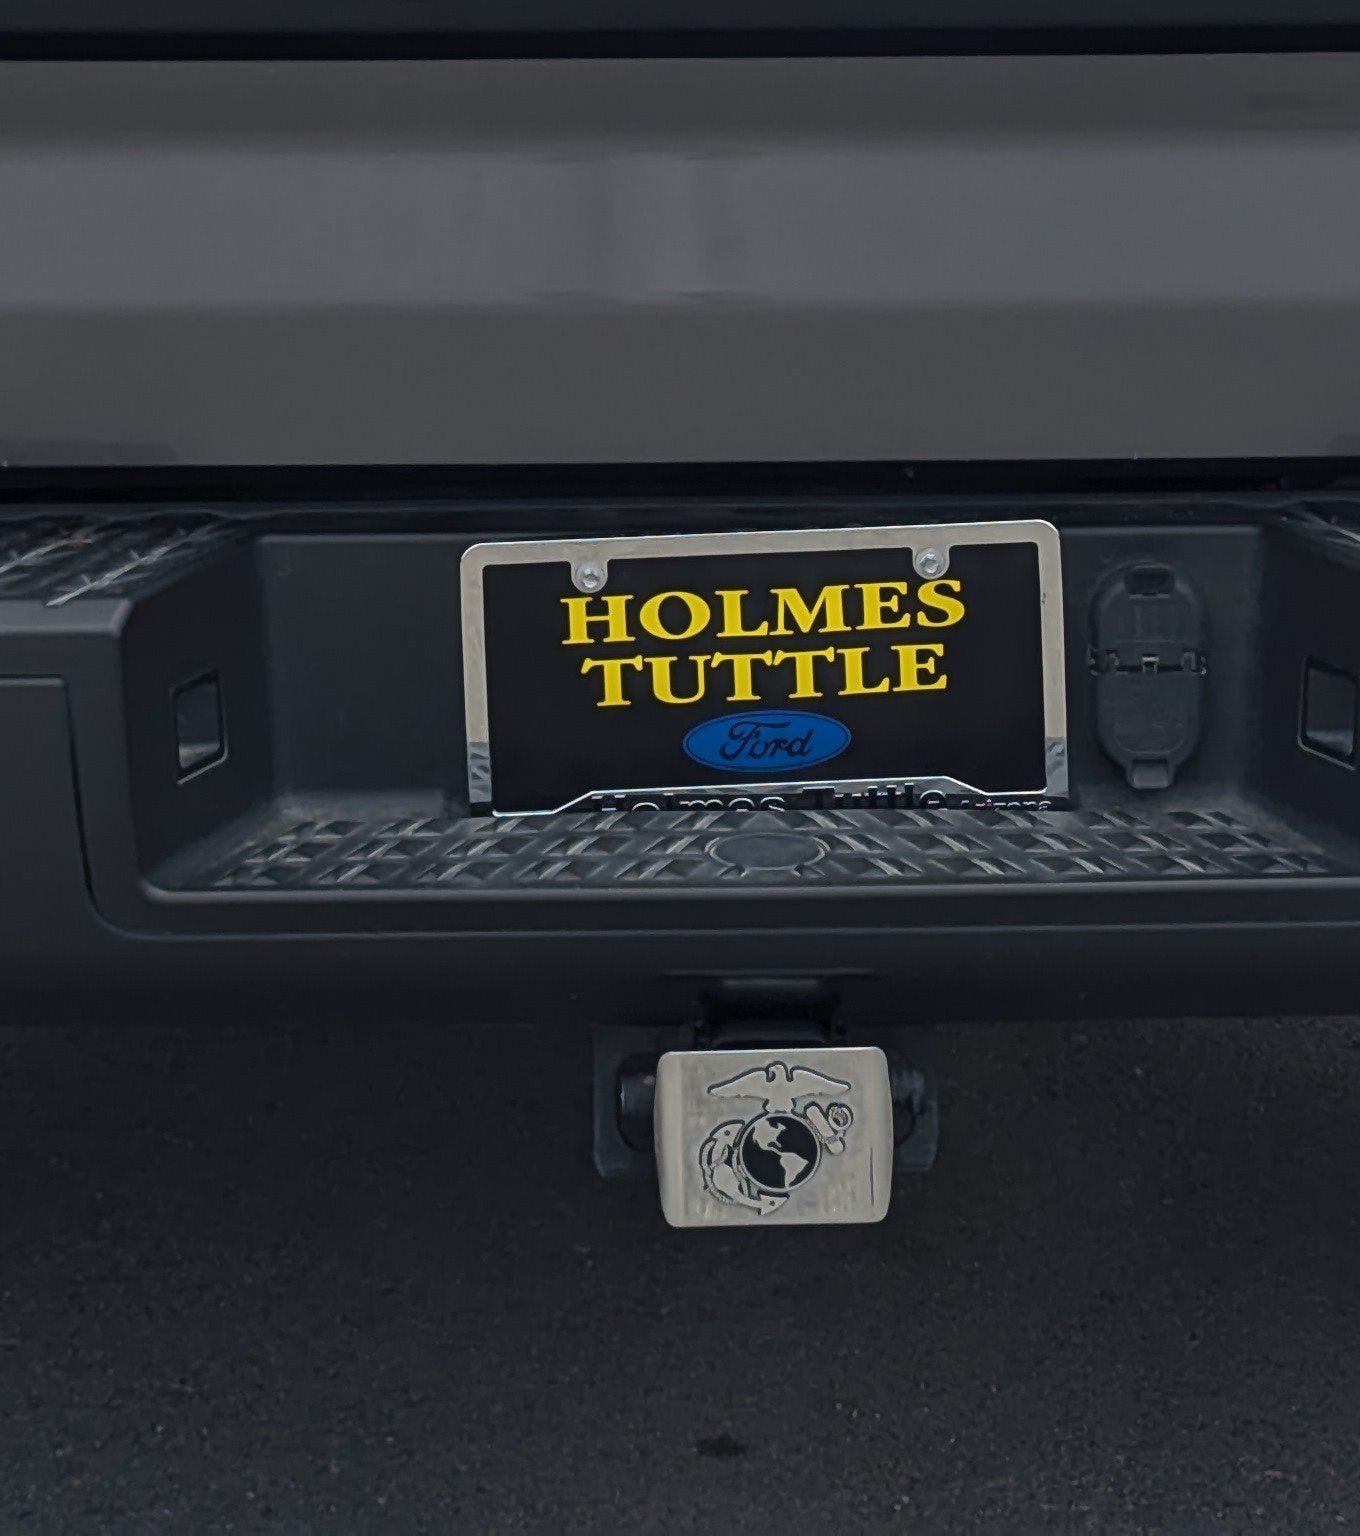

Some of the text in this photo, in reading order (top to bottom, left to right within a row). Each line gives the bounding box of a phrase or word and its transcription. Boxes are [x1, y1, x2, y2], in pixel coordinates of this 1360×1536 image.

[559, 579, 966, 645] HOLMES
[580, 643, 948, 707] TUTTLE
[720, 720, 815, 760] Ford
